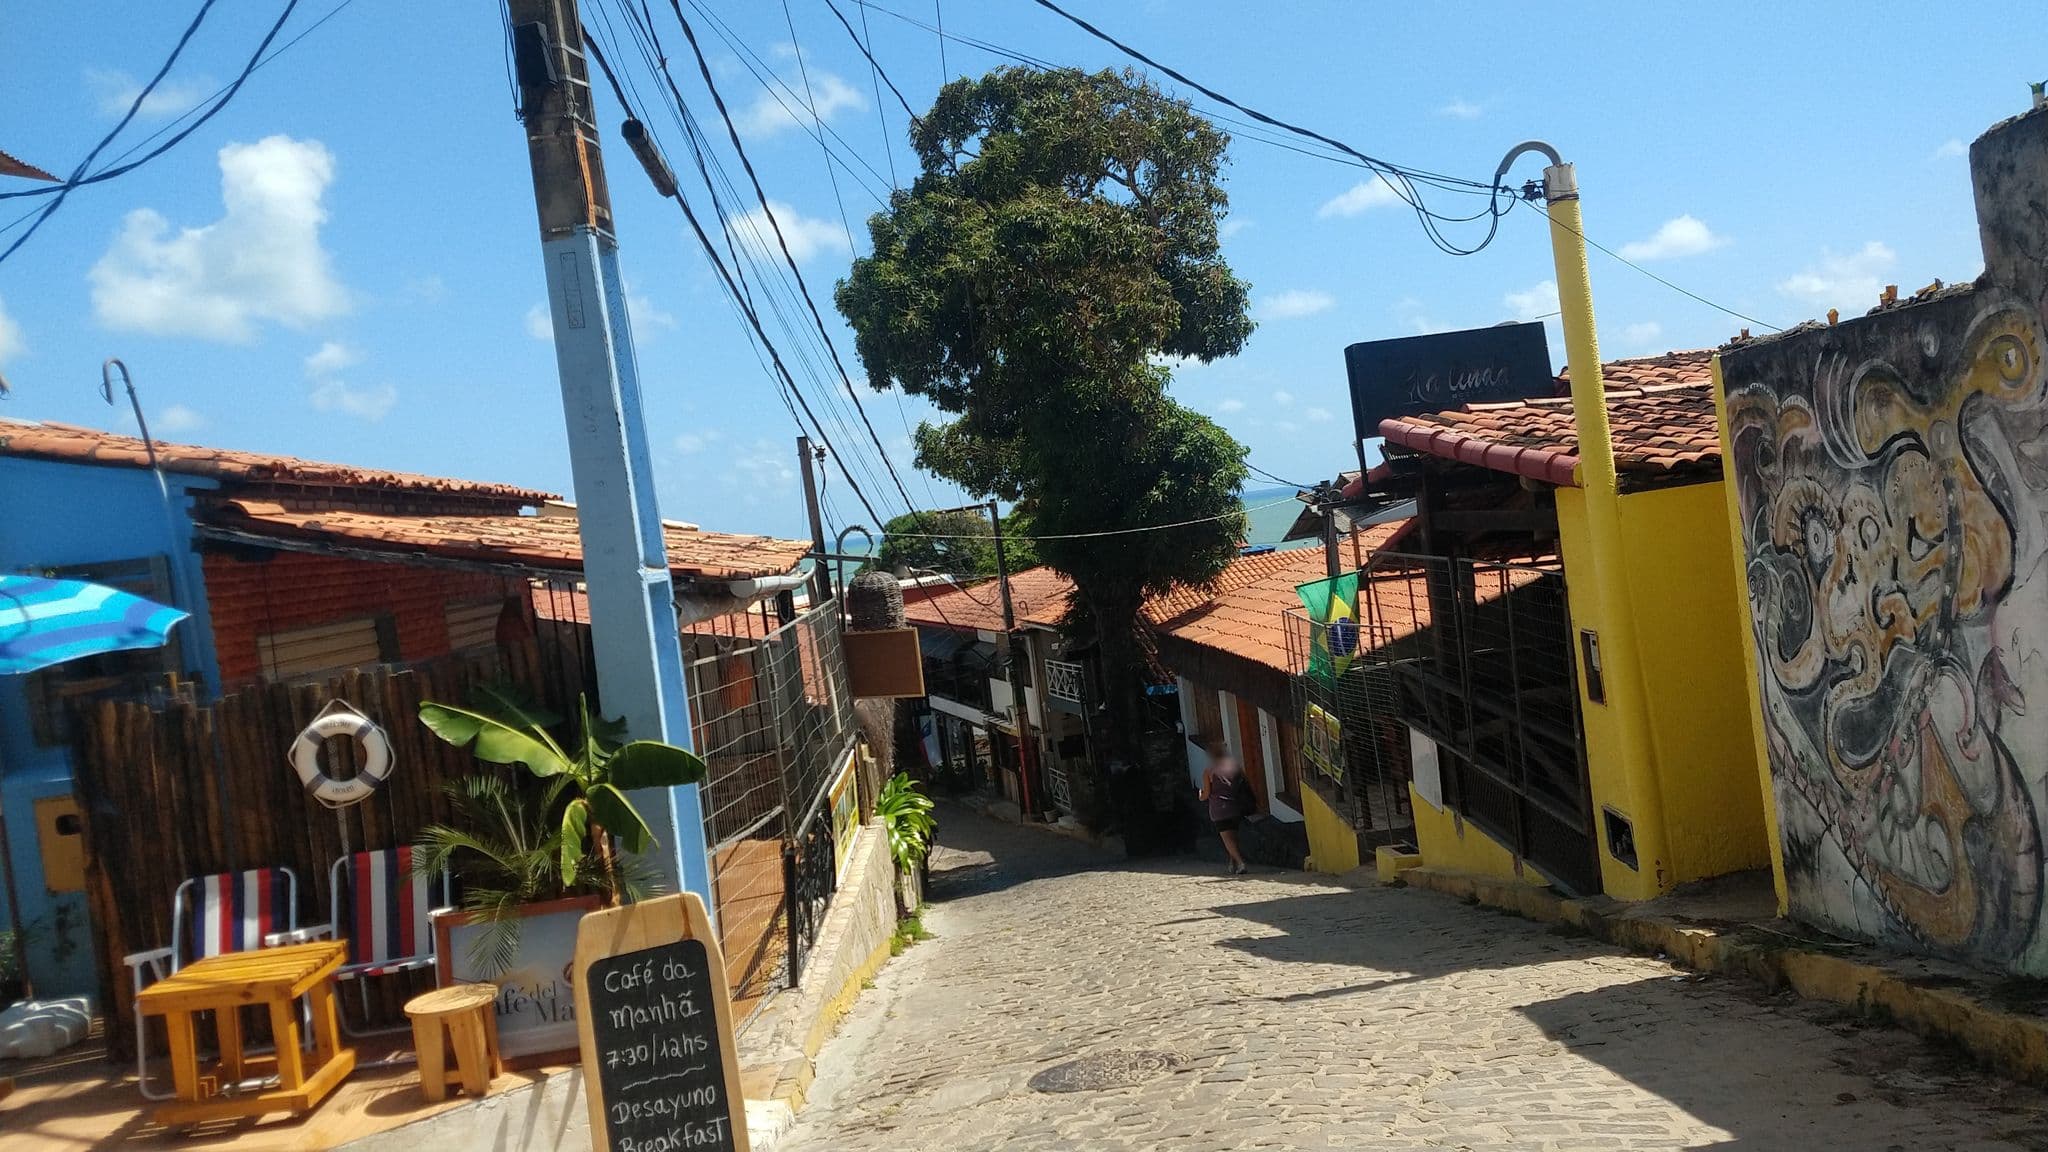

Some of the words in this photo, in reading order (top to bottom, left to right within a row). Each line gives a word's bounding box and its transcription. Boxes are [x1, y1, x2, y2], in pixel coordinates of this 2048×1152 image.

[530, 980, 558, 1000] del
[604, 959, 653, 993] Café
[662, 956, 697, 982] da
[494, 986, 528, 1017] fé
[535, 998, 577, 1023] Ma
[605, 1032, 708, 1070] 7:30/12hs
[611, 1085, 716, 1125] Desayuno
